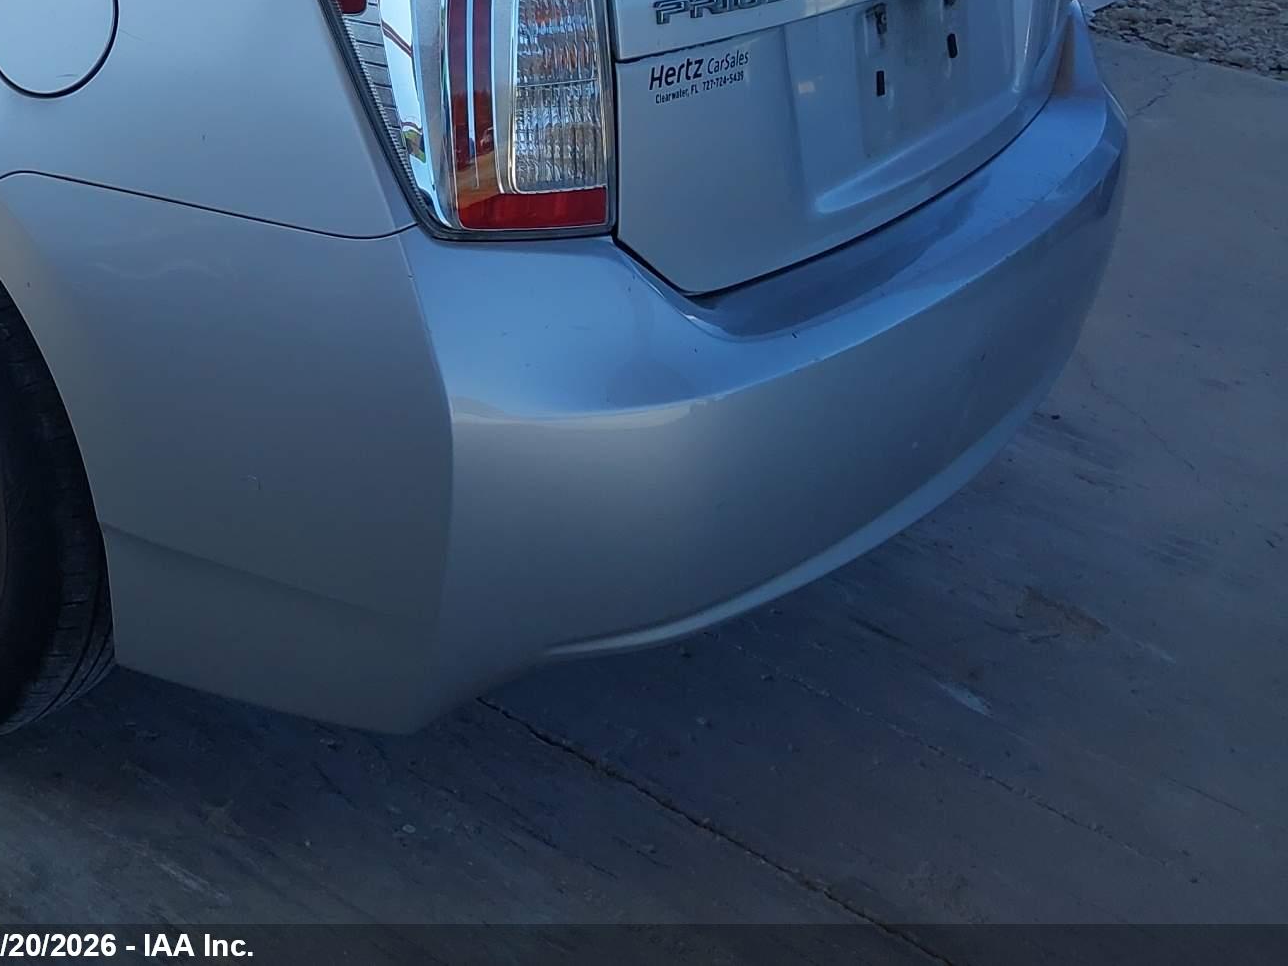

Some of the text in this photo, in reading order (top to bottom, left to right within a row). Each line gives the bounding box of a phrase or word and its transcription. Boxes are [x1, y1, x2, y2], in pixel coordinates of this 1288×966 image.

[649, 50, 749, 90] Hertz CarSales
[655, 87, 690, 104] Clearwater,
[690, 84, 699, 94] FL
